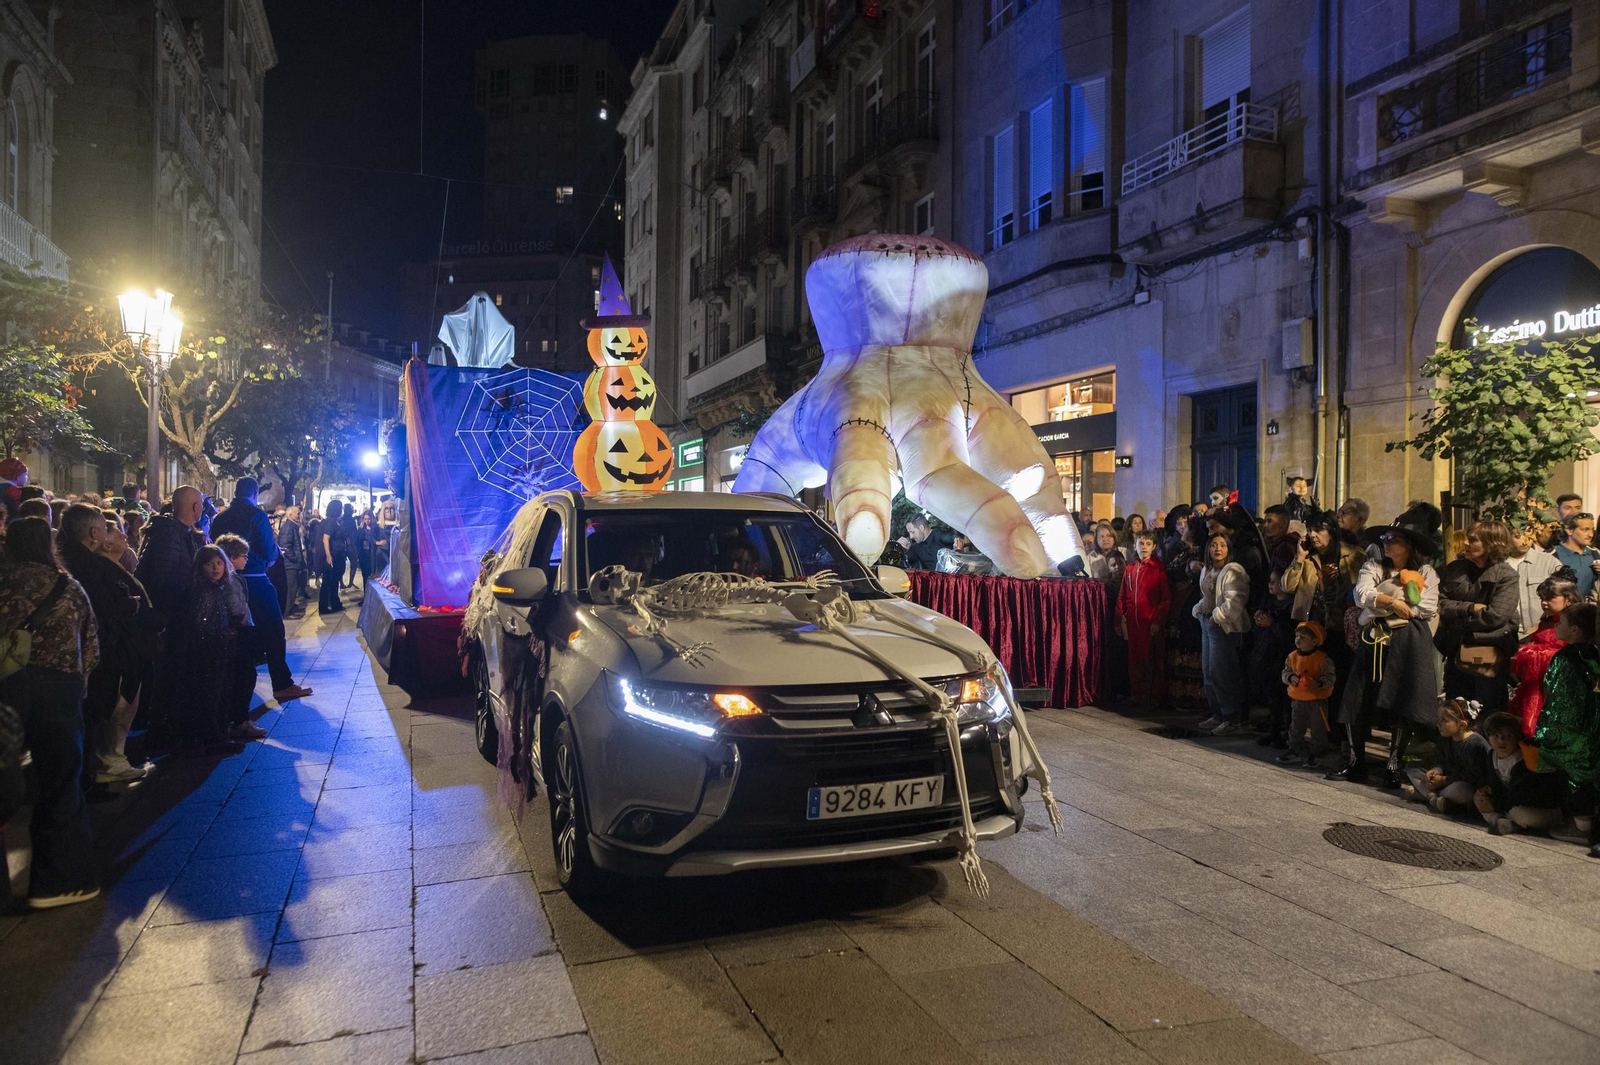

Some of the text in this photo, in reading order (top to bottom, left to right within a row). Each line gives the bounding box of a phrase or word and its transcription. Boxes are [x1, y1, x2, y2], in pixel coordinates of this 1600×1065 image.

[493, 239, 554, 253] Ourense
[1554, 303, 1600, 334] Dutti
[825, 786, 886, 814] 9284
[894, 779, 939, 807] KFY
